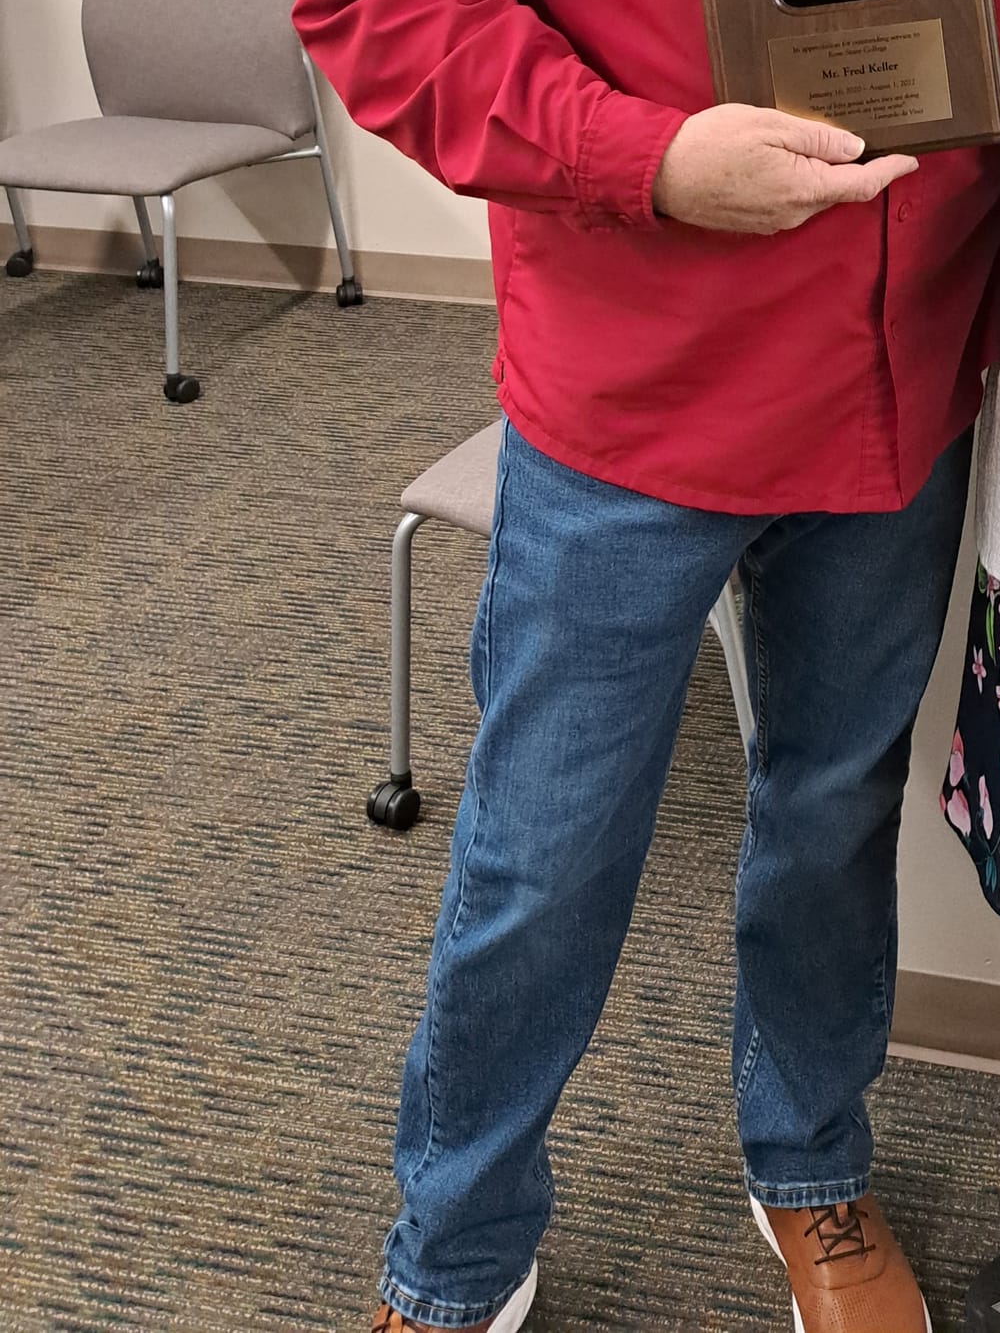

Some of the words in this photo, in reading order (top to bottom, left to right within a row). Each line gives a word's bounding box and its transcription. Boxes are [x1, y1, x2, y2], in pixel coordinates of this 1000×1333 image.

[822, 68, 840, 80] Mr.
[842, 64, 866, 78] Fred
[868, 61, 899, 74] Keller
